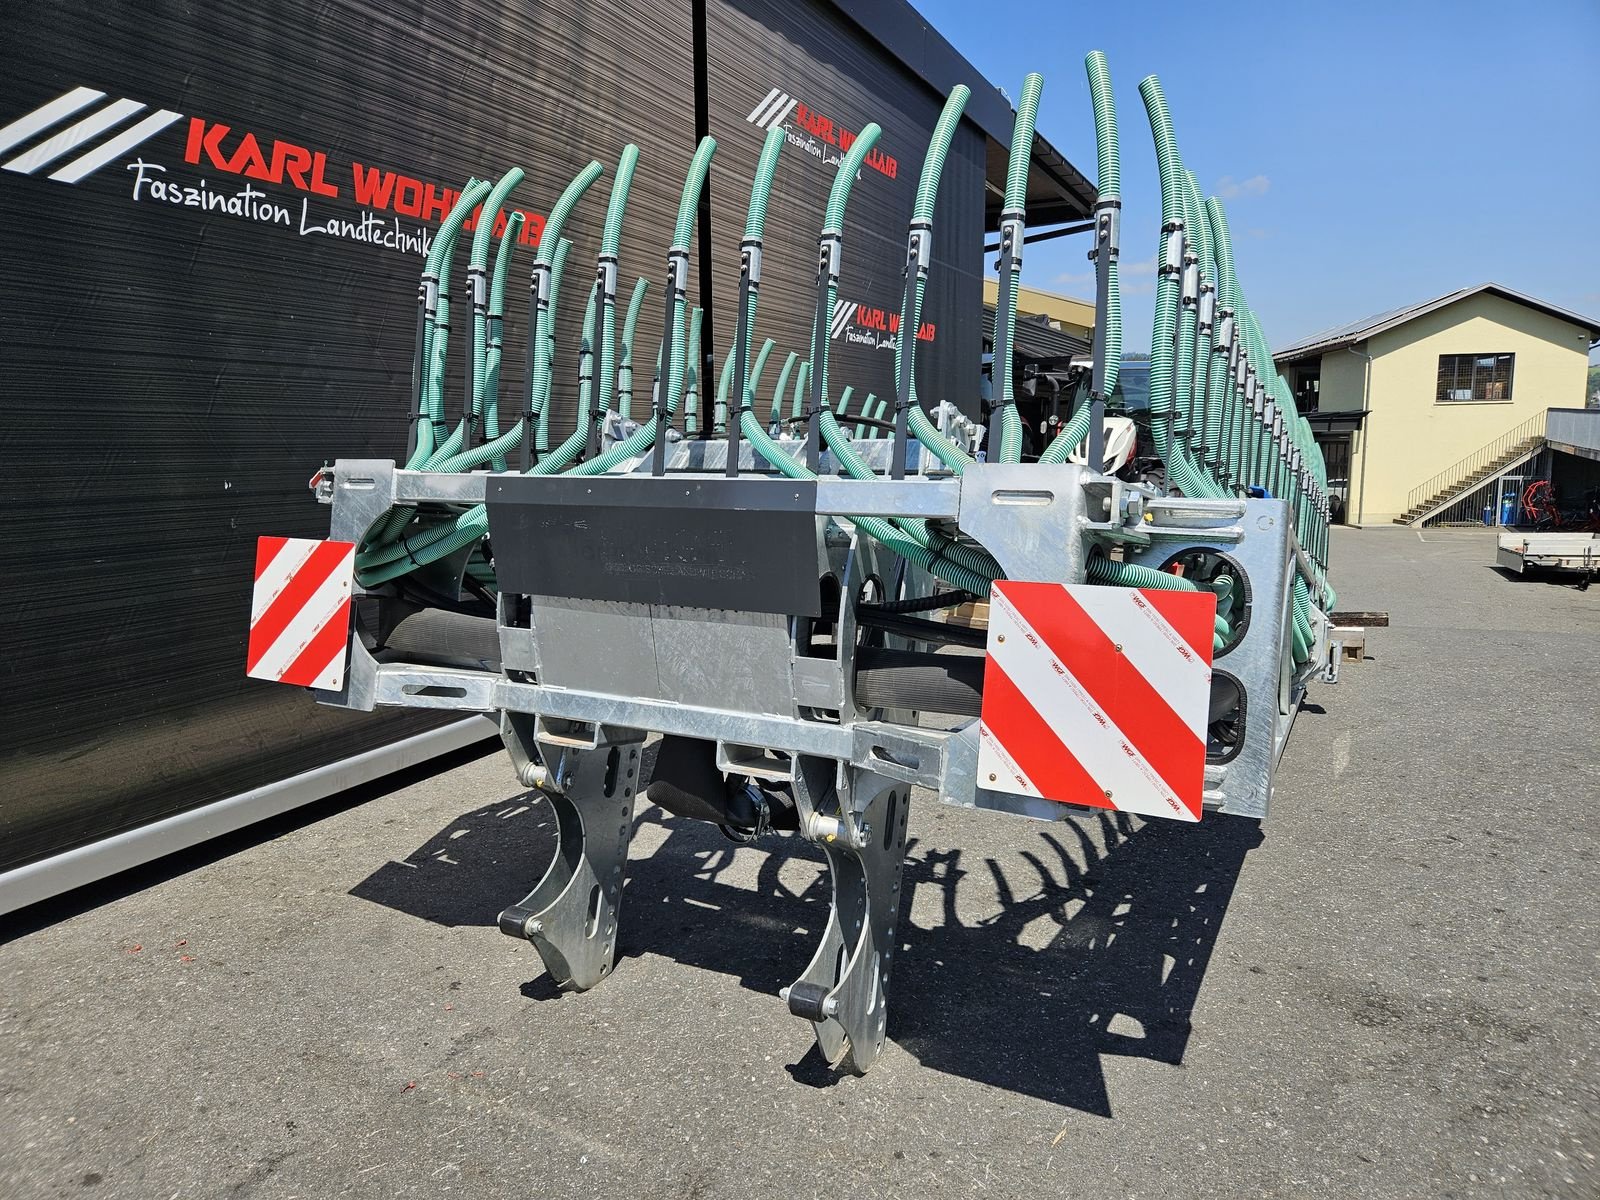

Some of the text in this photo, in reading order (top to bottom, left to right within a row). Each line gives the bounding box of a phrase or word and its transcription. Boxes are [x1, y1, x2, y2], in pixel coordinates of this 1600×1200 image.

[185, 118, 338, 197] KARL
[797, 101, 897, 179] KARL WLLAIB
[128, 158, 431, 258] Faszination Landtechnik
[856, 304, 886, 331] KARL
